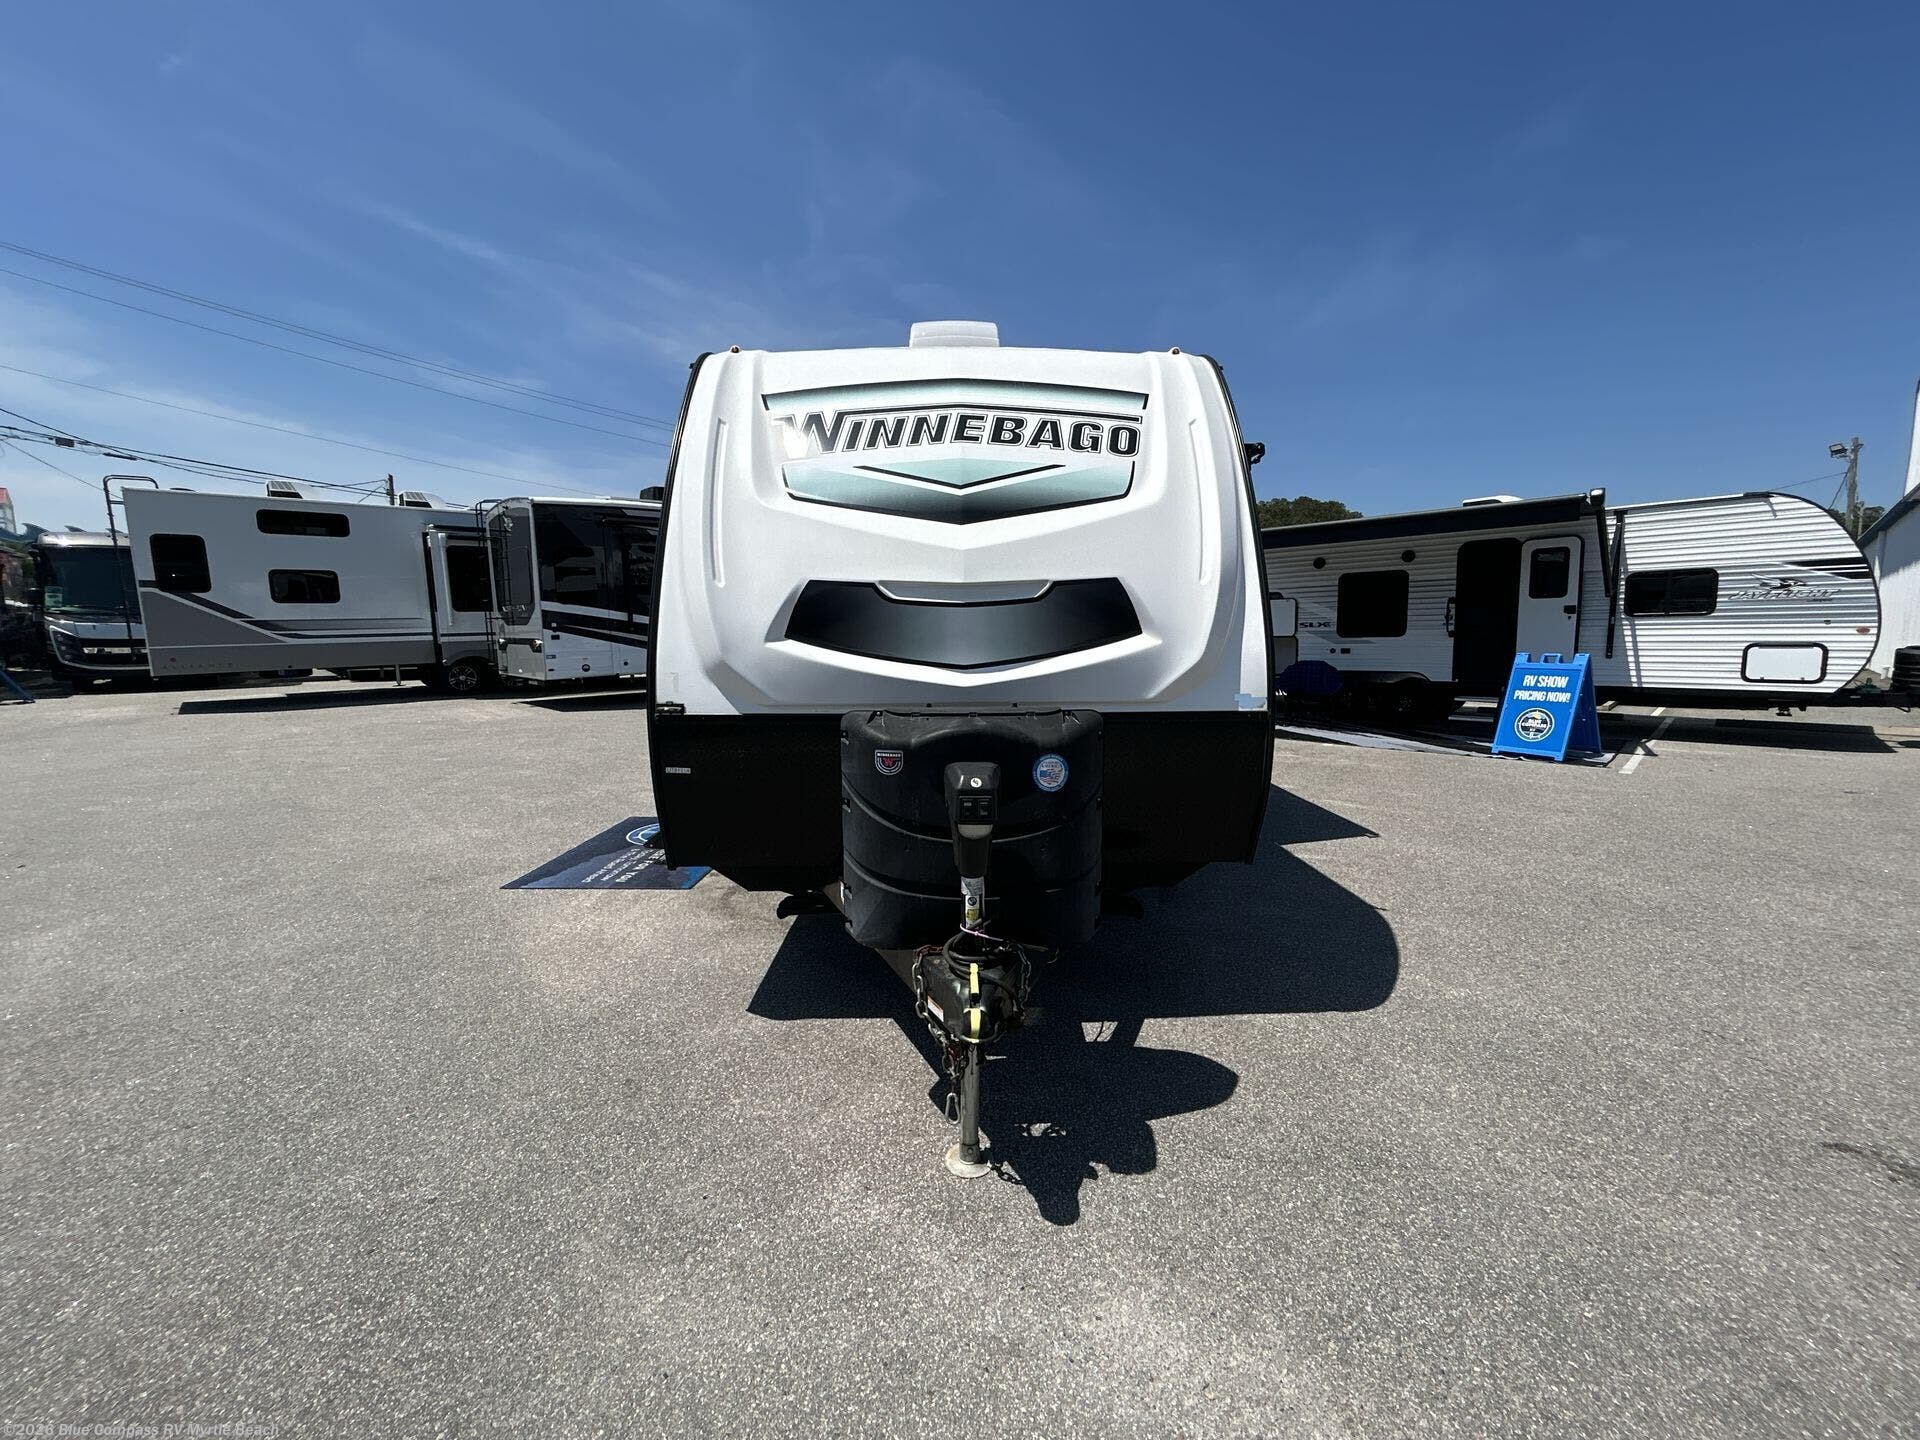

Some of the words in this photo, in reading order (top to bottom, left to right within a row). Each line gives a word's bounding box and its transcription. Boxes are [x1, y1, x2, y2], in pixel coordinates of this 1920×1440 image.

[774, 409, 1142, 458] WINNEBAGO
[1523, 675, 1537, 687] RV
[1537, 676, 1569, 688] SHOW
[1514, 691, 1546, 701] PRICING
[1546, 691, 1571, 703] NOW!
